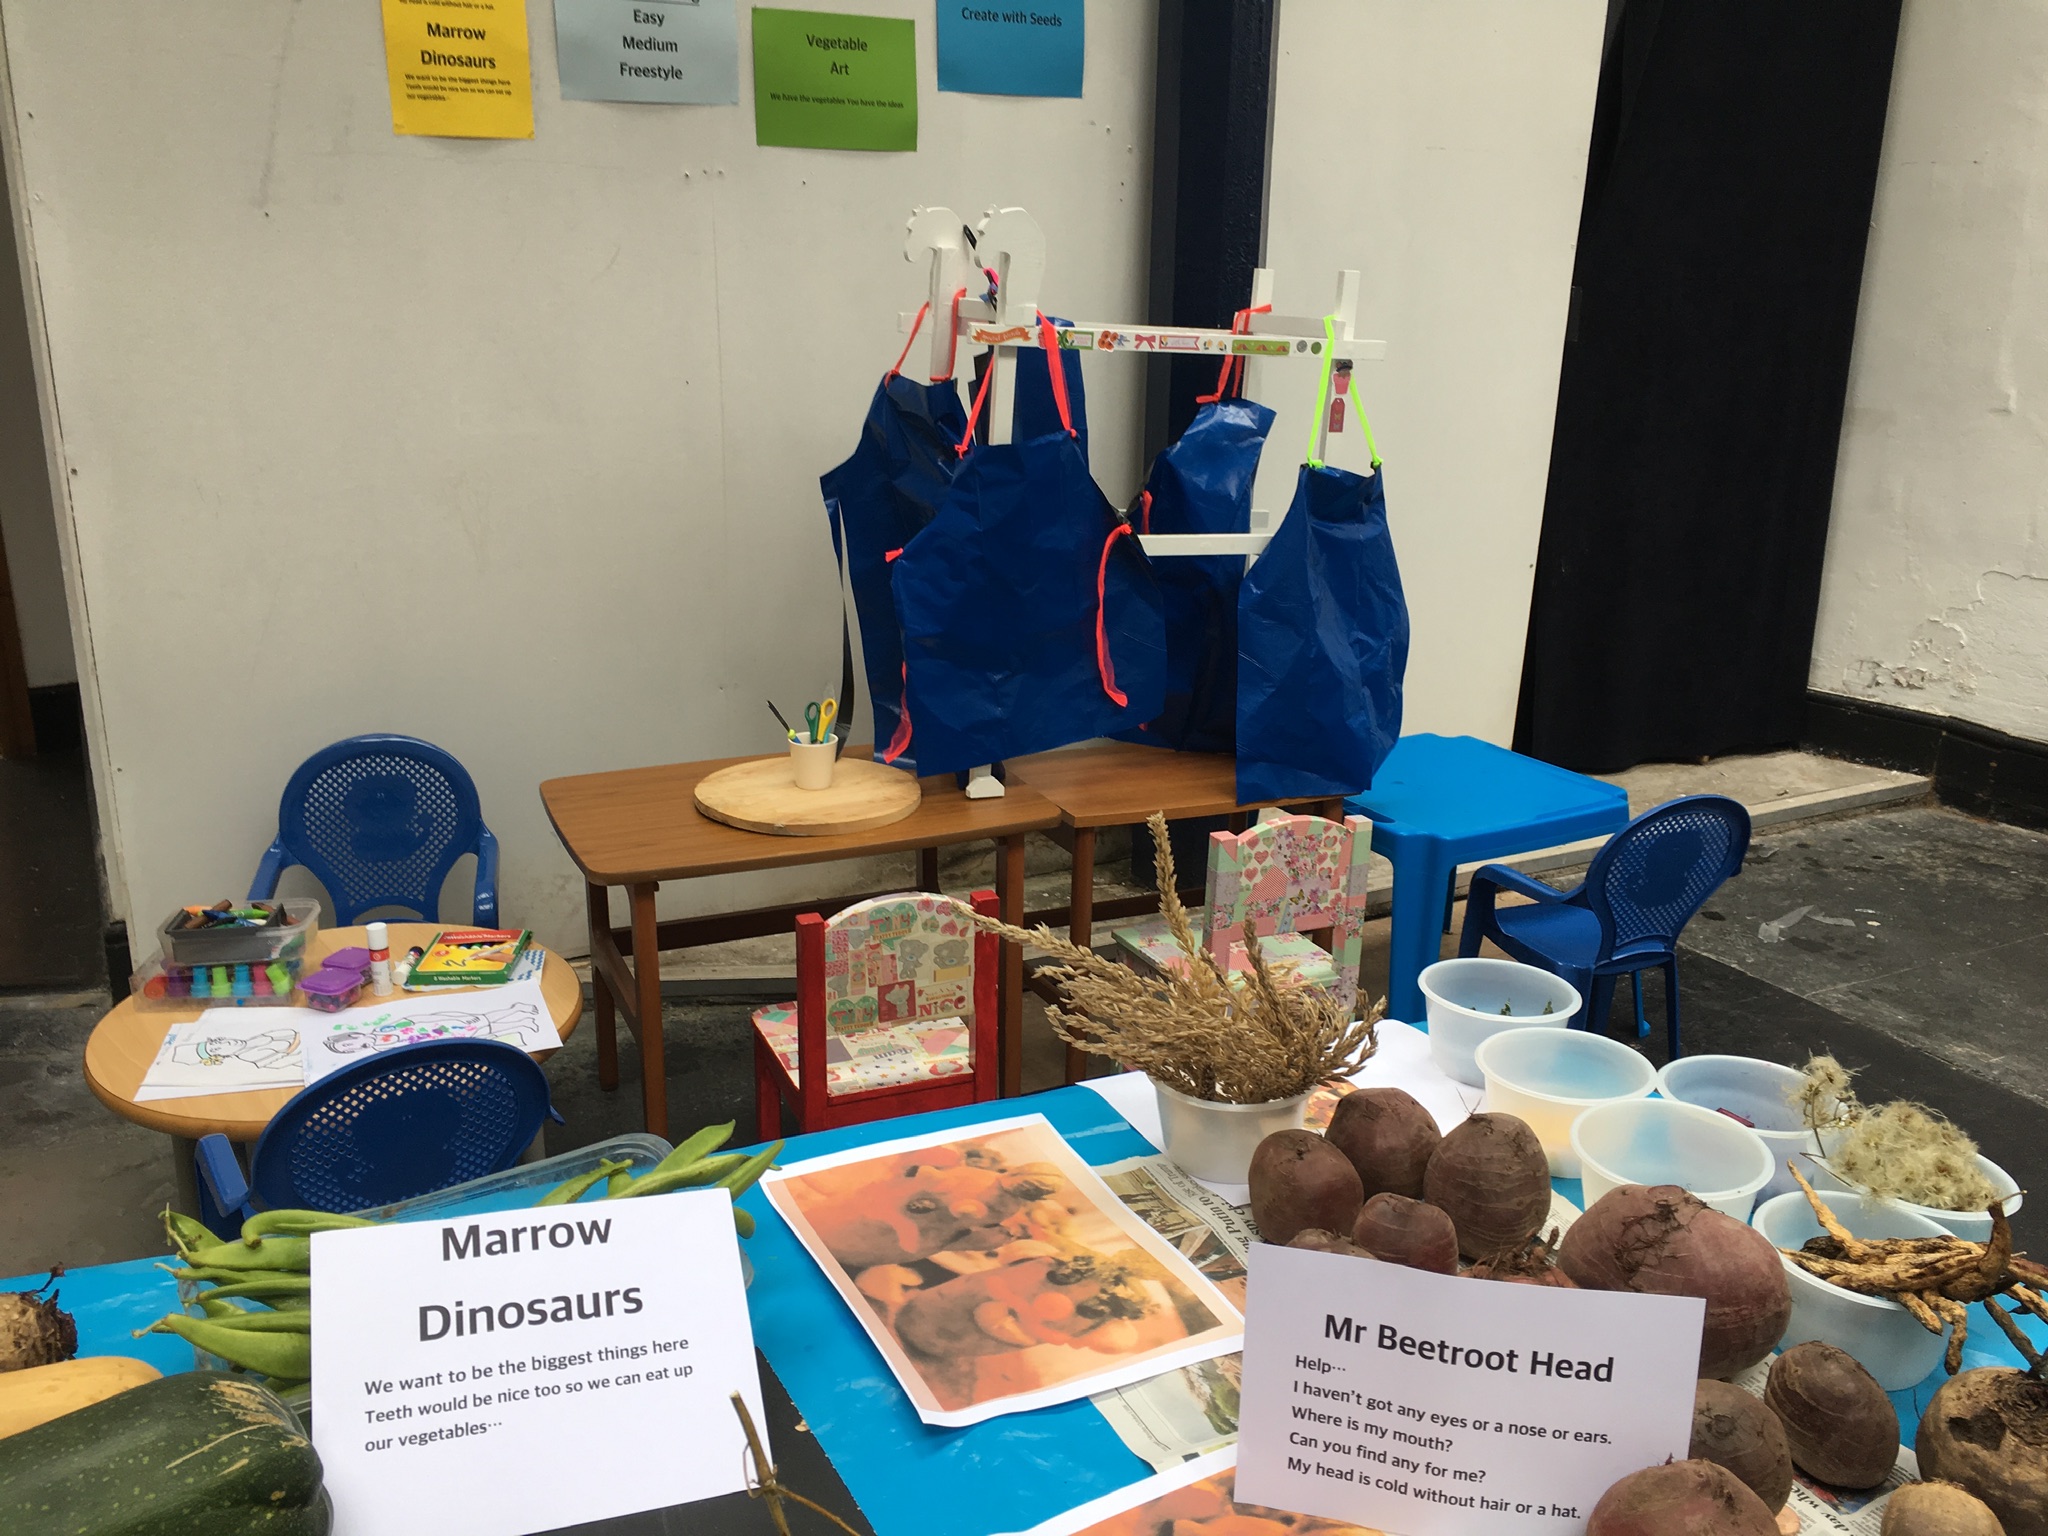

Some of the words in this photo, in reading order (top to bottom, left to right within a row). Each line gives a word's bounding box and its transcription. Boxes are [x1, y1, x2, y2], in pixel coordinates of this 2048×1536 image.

[633, 9, 666, 28] Easy
[961, 7, 999, 23] Create
[1002, 10, 1027, 25] with
[1030, 12, 1063, 27] Seeds
[426, 21, 487, 41] Marrow
[806, 34, 868, 52] Vegetable
[622, 35, 679, 53] Medium
[420, 49, 496, 69] Dinosaurs
[619, 61, 683, 81] Freestyle
[830, 61, 850, 76] Art
[1210, 1205, 1241, 1234] Putin
[442, 1218, 612, 1261] Marrow
[419, 1287, 643, 1342] Dinosaurs
[1325, 1314, 1367, 1343] Mr
[1378, 1324, 1519, 1373] Beetroot
[1530, 1351, 1614, 1382] Head
[364, 1380, 393, 1395] We
[399, 1373, 443, 1390] want
[448, 1371, 466, 1383] to
[472, 1366, 493, 1380] be
[498, 1360, 526, 1375] the
[532, 1351, 593, 1371] biggest
[597, 1345, 648, 1361] things
[652, 1339, 689, 1354] here
[365, 1405, 412, 1424] Teeth
[418, 1395, 467, 1416] would
[473, 1393, 492, 1407] be
[498, 1388, 530, 1403] nice
[534, 1385, 561, 1397] too
[566, 1382, 583, 1393] so
[587, 1378, 610, 1390] we
[615, 1374, 641, 1386] can
[646, 1367, 670, 1381] eat
[674, 1365, 693, 1378] up
[1294, 1380, 1298, 1392] I
[1303, 1381, 1362, 1405] haven't
[1366, 1398, 1393, 1412] got
[1397, 1405, 1426, 1422] any
[1430, 1414, 1467, 1428] eyes
[1472, 1420, 1490, 1431] or
[1494, 1422, 1503, 1433] a
[1508, 1424, 1547, 1437] nose
[1552, 1429, 1570, 1440] or
[1574, 1432, 1611, 1444] ears.
[1292, 1406, 1342, 1427] Where
[1347, 1416, 1359, 1431] is
[1364, 1423, 1388, 1439] my
[1393, 1431, 1453, 1452] mouth?
[365, 1438, 393, 1452] our
[1289, 1432, 1318, 1448] Can
[1322, 1441, 1351, 1455] you
[1356, 1445, 1387, 1464] find
[1391, 1456, 1420, 1473] any
[1425, 1462, 1448, 1477] for
[1453, 1470, 1486, 1483] me?
[1288, 1457, 1311, 1474] My
[1316, 1462, 1354, 1482] head
[1359, 1471, 1371, 1485] is
[1375, 1479, 1408, 1495] cold
[1413, 1488, 1475, 1508] without
[1480, 1496, 1511, 1511] hair
[1515, 1504, 1533, 1514] or
[1537, 1506, 1546, 1515] a
[1551, 1504, 1580, 1519] hat.
[1820, 1512, 1850, 1532] day
